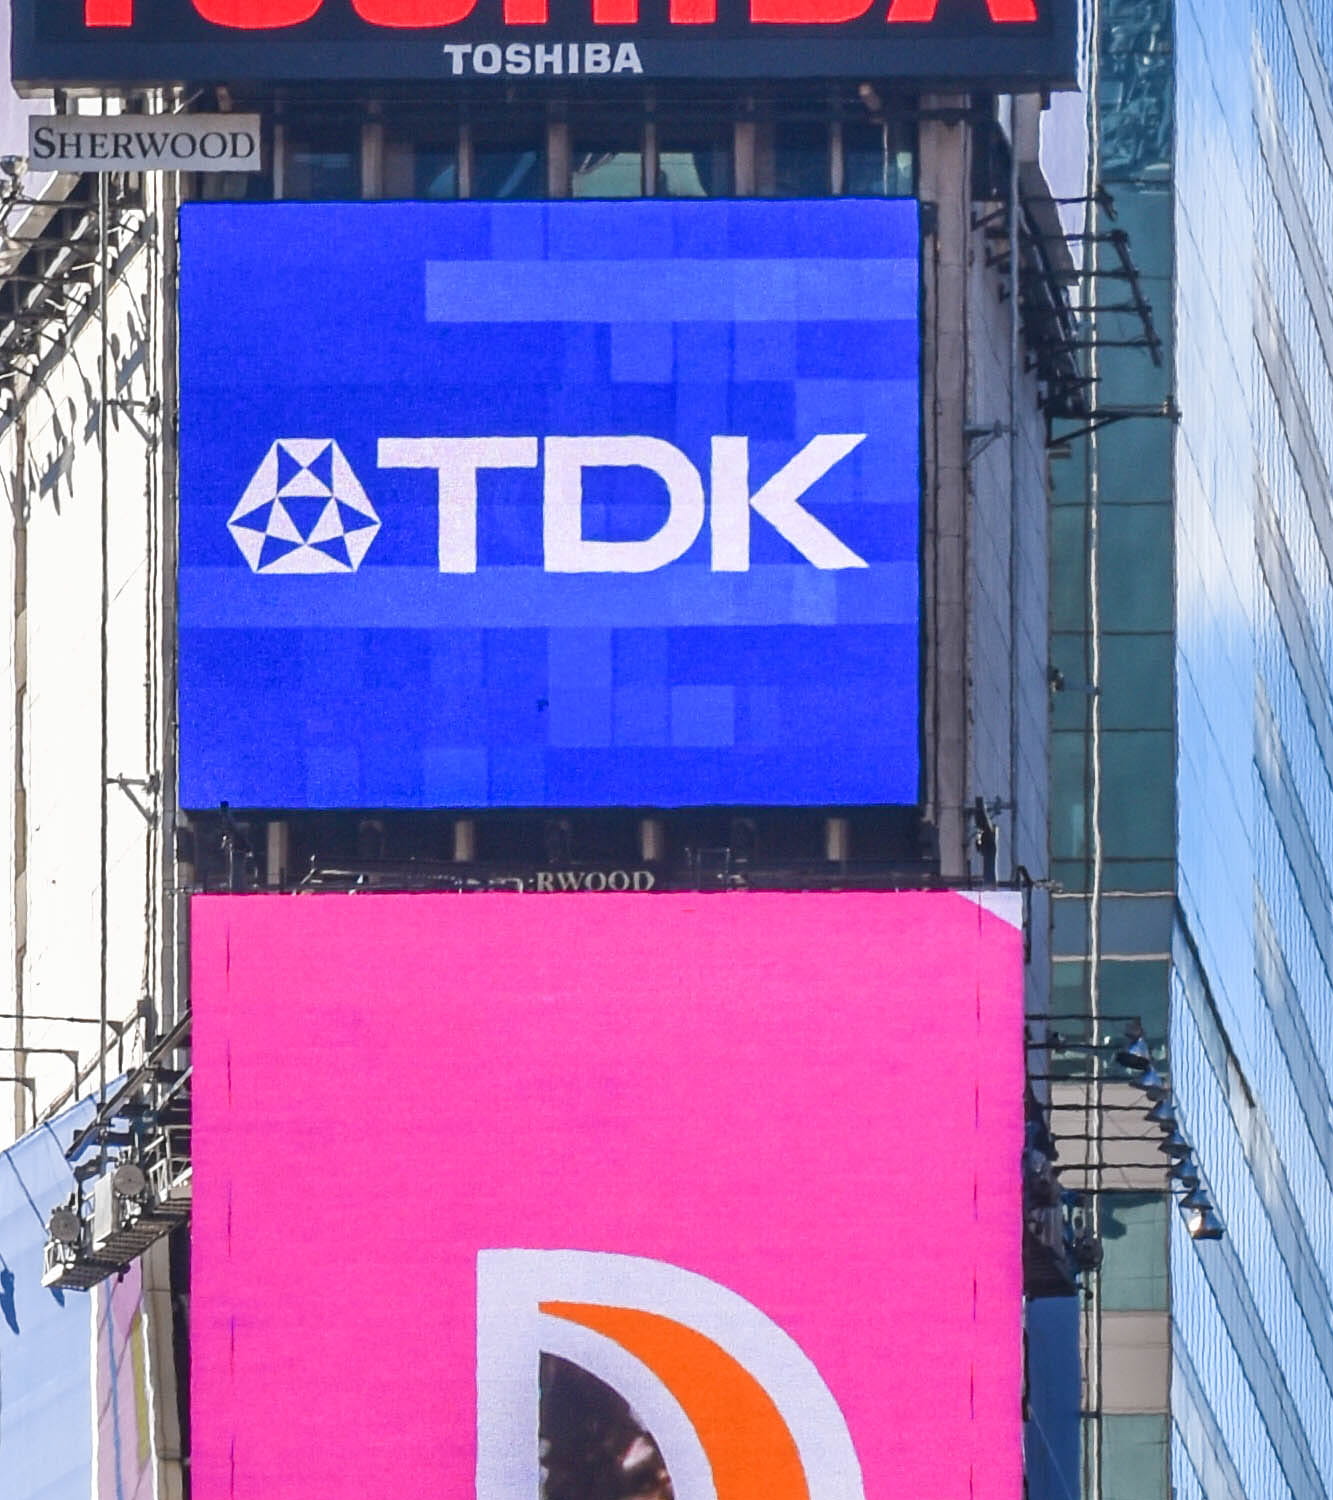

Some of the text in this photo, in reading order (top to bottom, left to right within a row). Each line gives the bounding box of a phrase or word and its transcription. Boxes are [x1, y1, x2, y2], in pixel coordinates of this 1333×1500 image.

[443, 43, 643, 75] TOSHIBA
[32, 127, 257, 161] SHERWOOD
[377, 433, 869, 573] TDK
[535, 870, 655, 893] RWOOD
